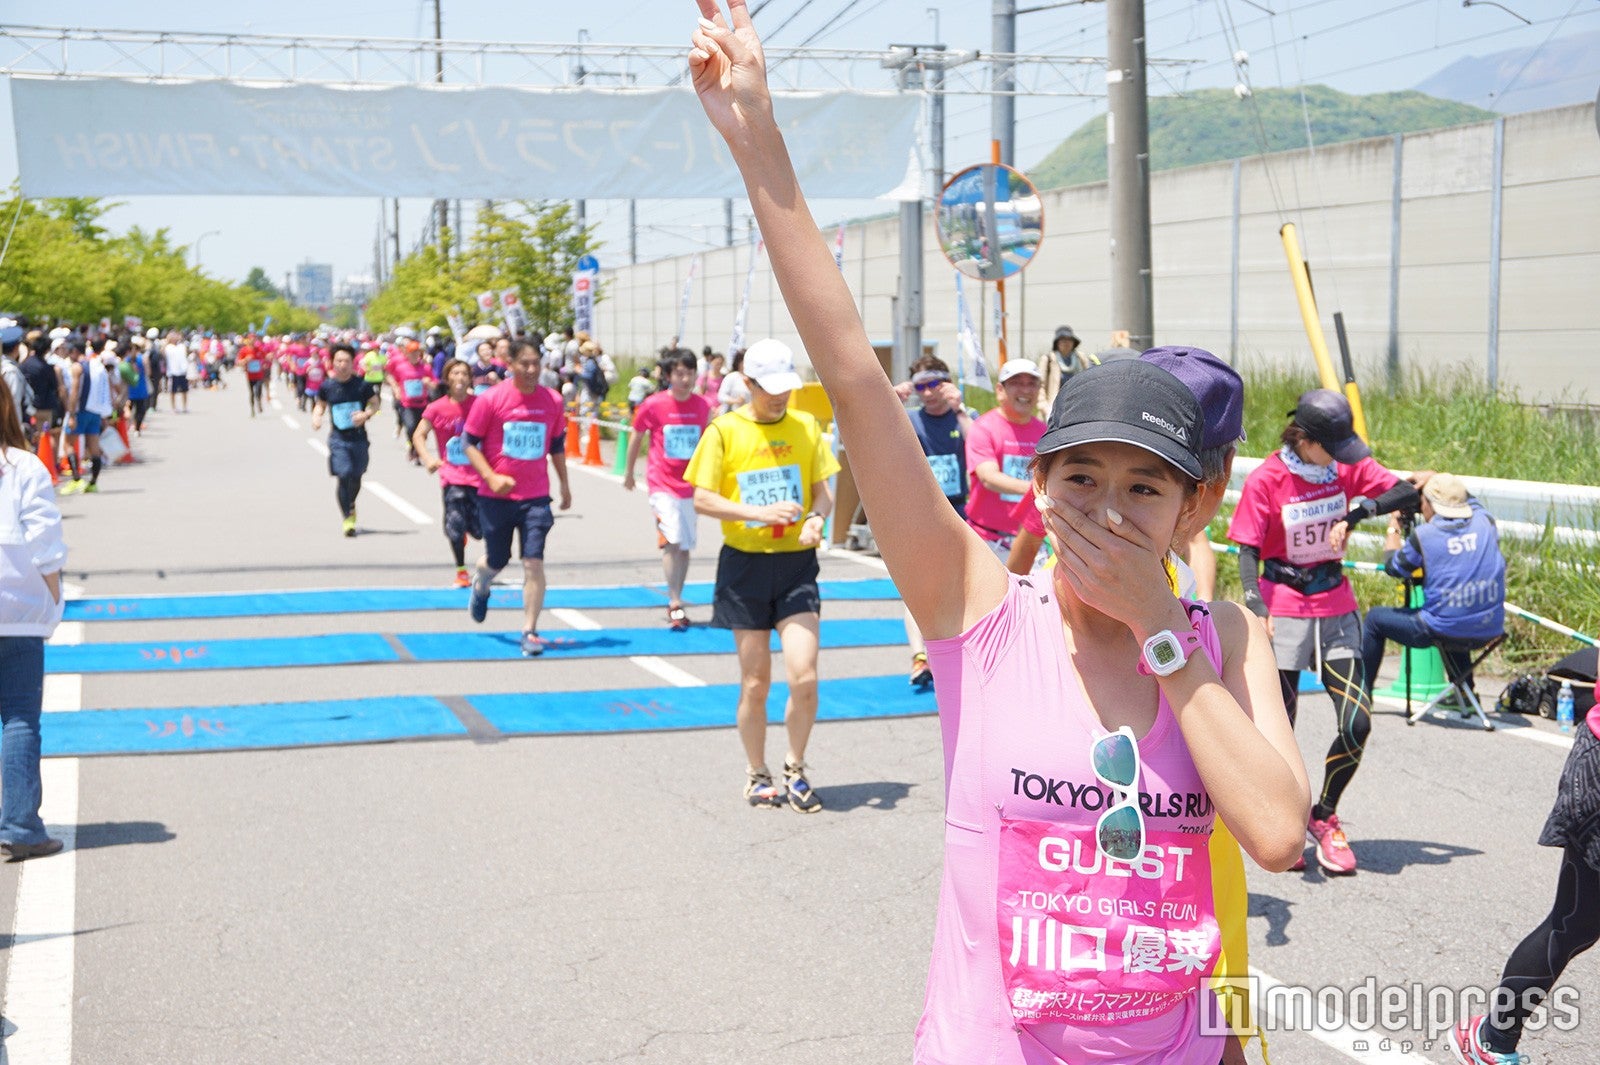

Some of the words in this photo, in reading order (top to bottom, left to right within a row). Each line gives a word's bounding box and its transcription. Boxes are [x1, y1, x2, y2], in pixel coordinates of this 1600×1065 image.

[1141, 411, 1177, 434] Reebok
[1010, 768, 1104, 812] TOKYO
[1106, 791, 1183, 818] GRLS
[1018, 890, 1092, 915] TOKYO
[1098, 897, 1156, 918] GIRLS
[1160, 902, 1197, 922] RUN
[1009, 916, 1107, 973] 川口
[1121, 924, 1214, 976] 優菜
